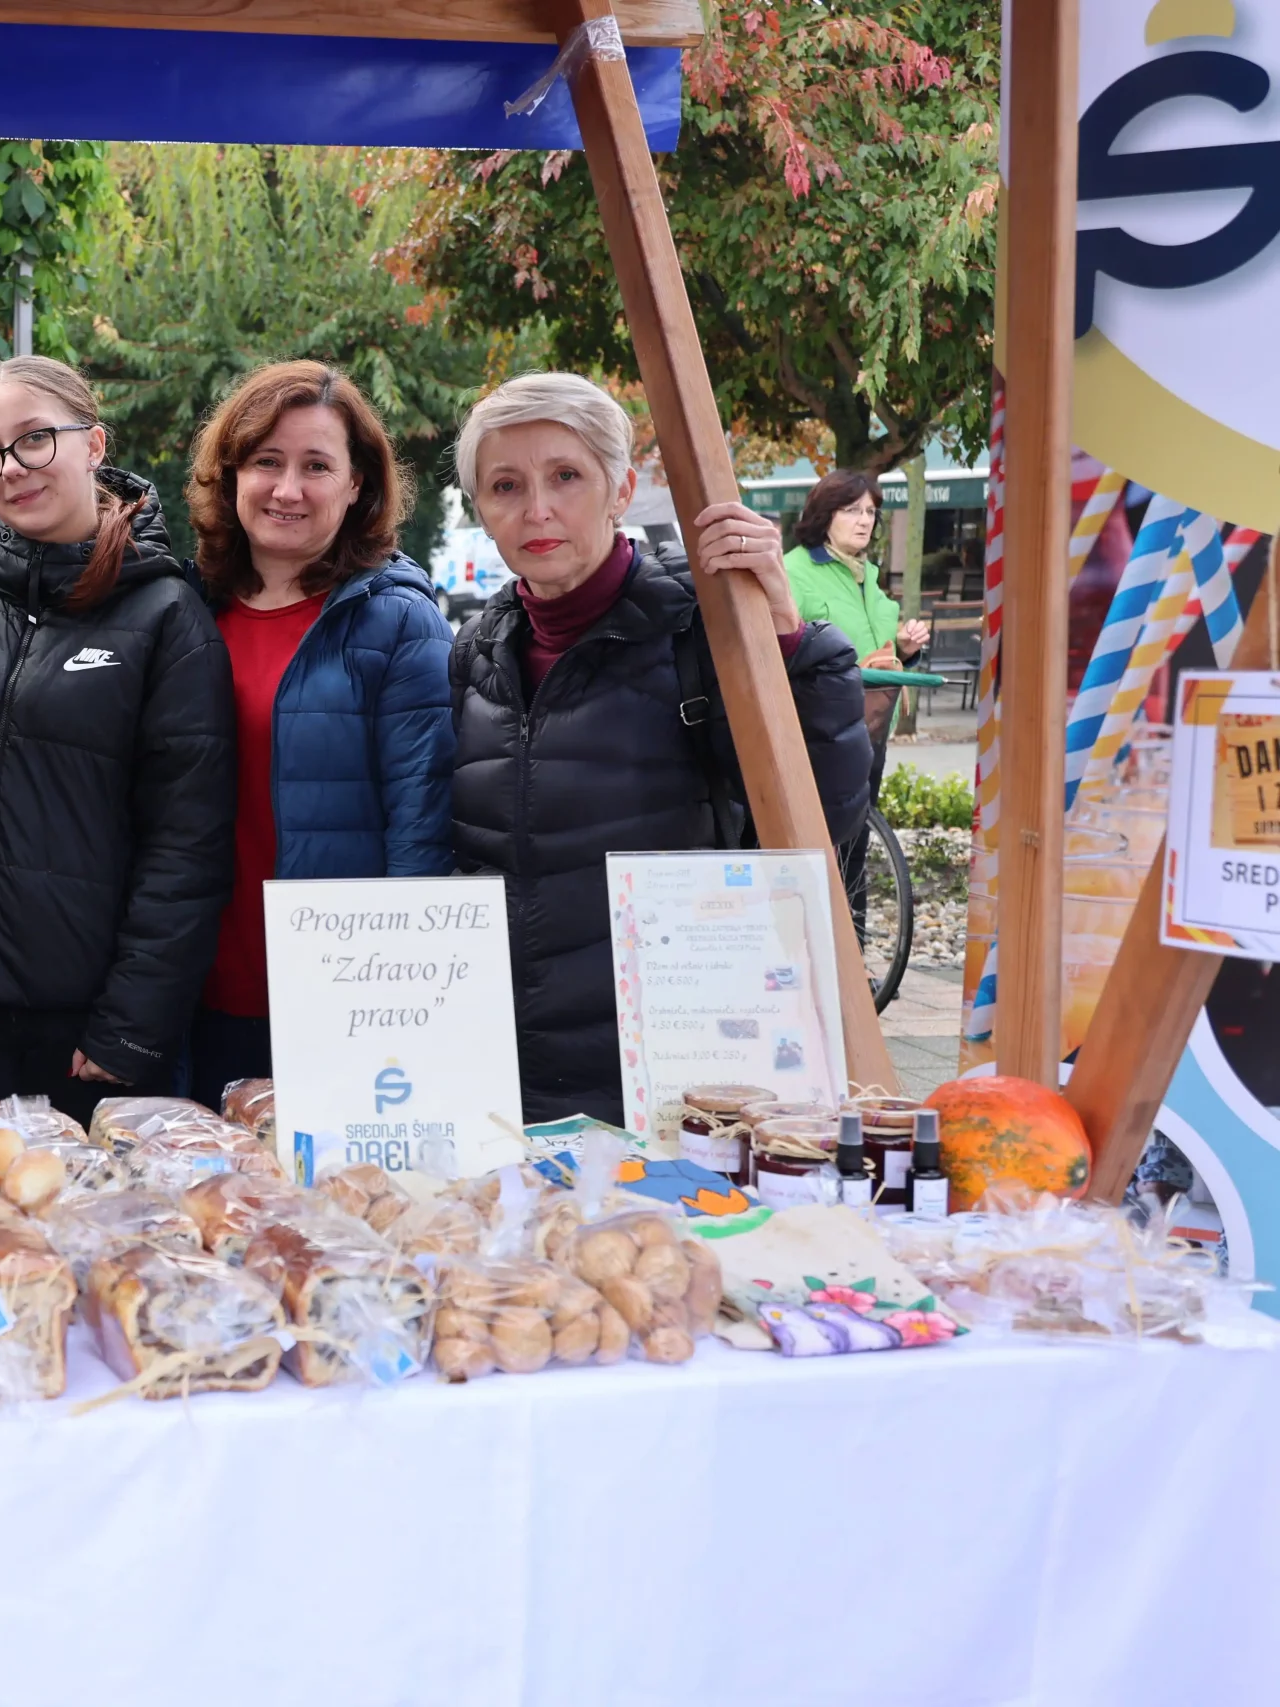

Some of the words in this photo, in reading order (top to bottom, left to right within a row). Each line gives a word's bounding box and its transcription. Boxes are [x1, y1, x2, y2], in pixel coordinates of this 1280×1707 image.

[73, 647, 115, 664] NIKE
[1222, 861, 1280, 887] SRED
[290, 906, 410, 941] Program
[418, 902, 491, 932] SHE
[321, 952, 438, 983] “Zdravo
[441, 954, 470, 990] je
[346, 996, 446, 1038] pravo”
[345, 1123, 408, 1139] SREDNJA
